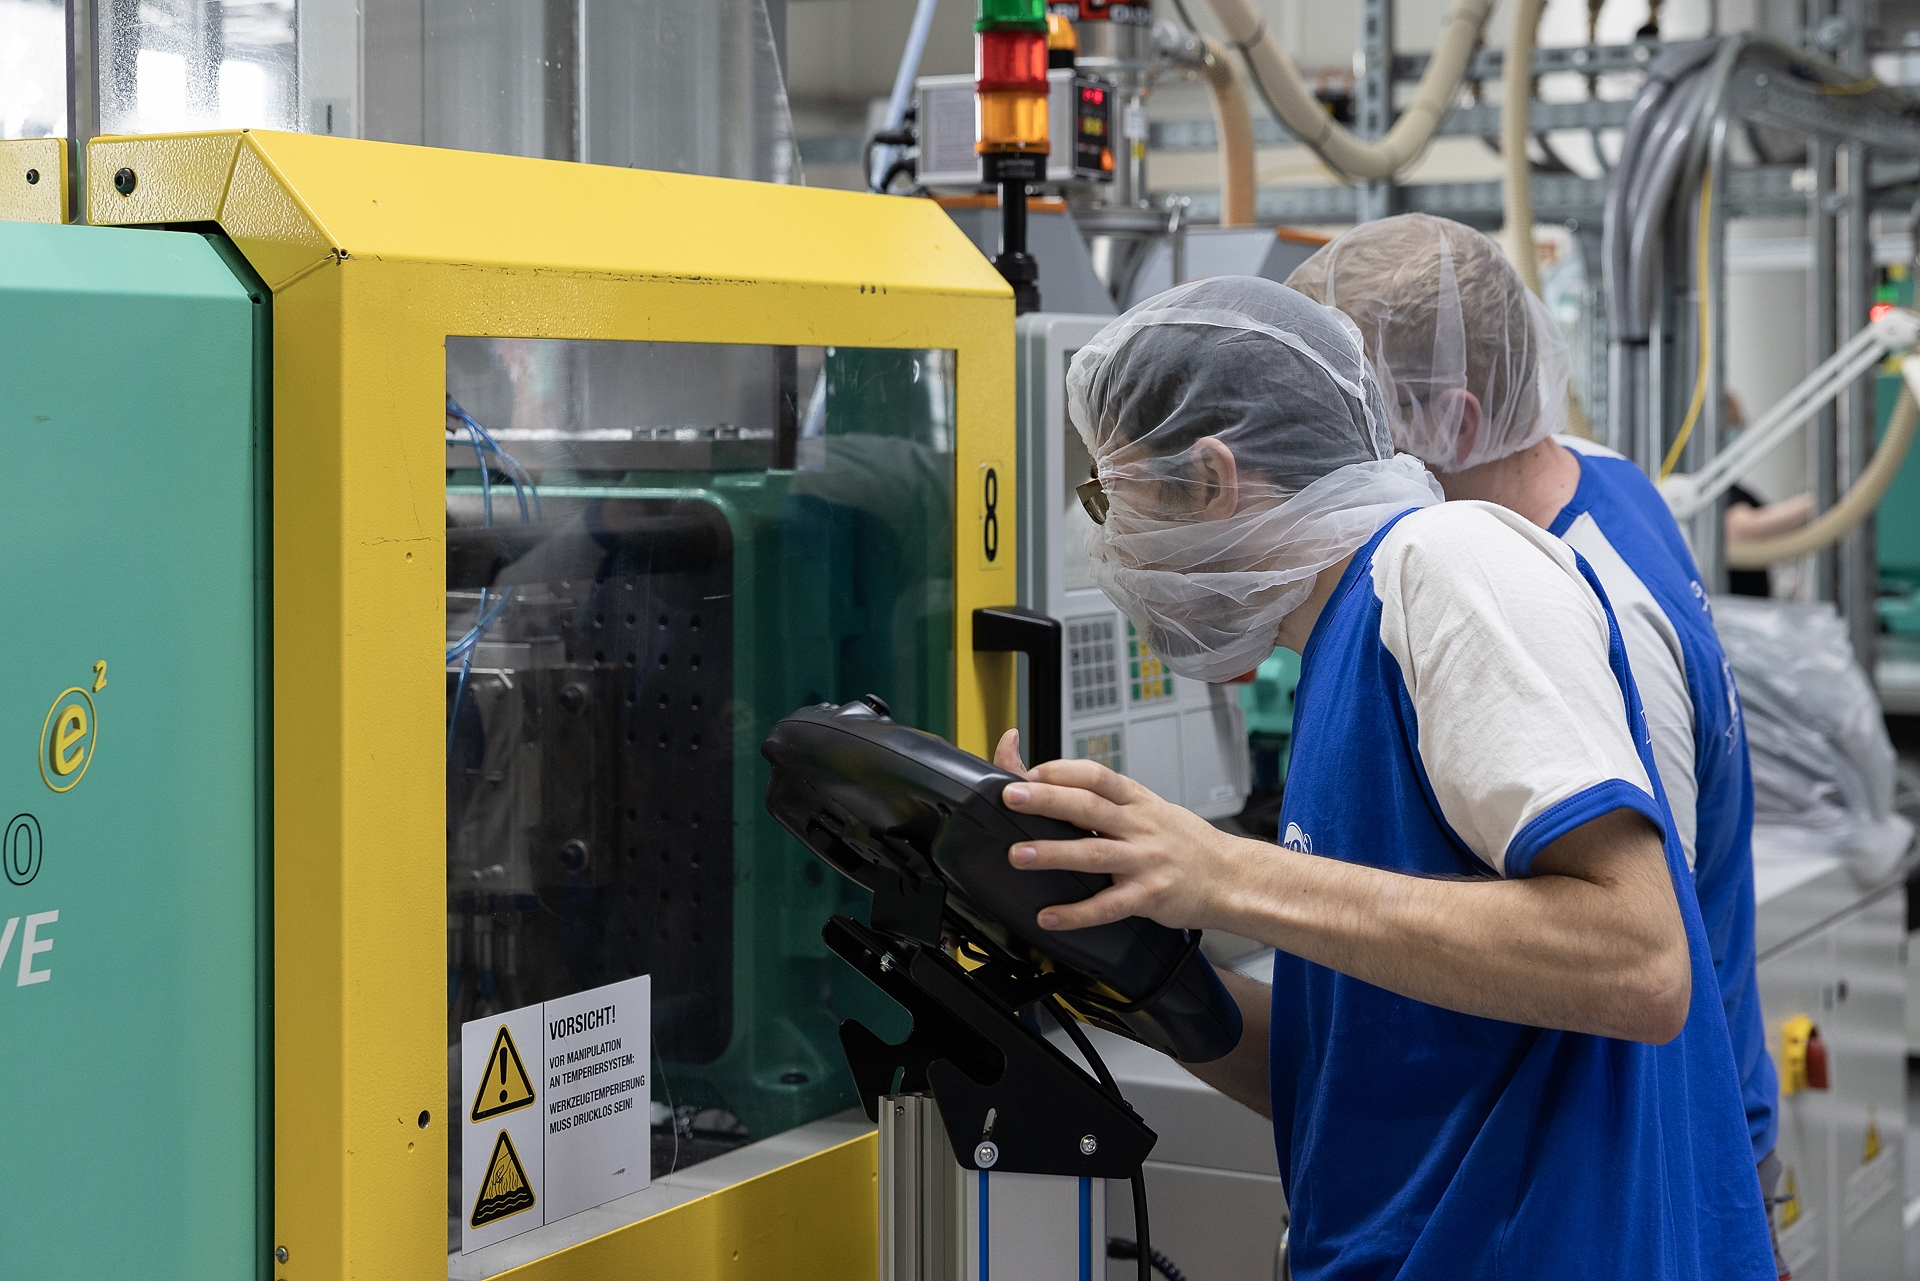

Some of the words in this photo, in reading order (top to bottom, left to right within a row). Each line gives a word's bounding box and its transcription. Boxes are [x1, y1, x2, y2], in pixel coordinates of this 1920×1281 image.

[549, 1005, 615, 1040] VORSICHT!
[549, 1055, 565, 1069] VOR
[567, 1038, 622, 1064] MANIPULATION
[549, 1075, 561, 1089] AN
[562, 1053, 635, 1085] TEMPERIERSYSTEM:
[549, 1075, 646, 1115] WERKZEUGTEMPERIERUNG
[549, 1117, 572, 1134] MUSS
[573, 1104, 613, 1127] DRUCKLOS
[614, 1097, 633, 1113] SEIN!
